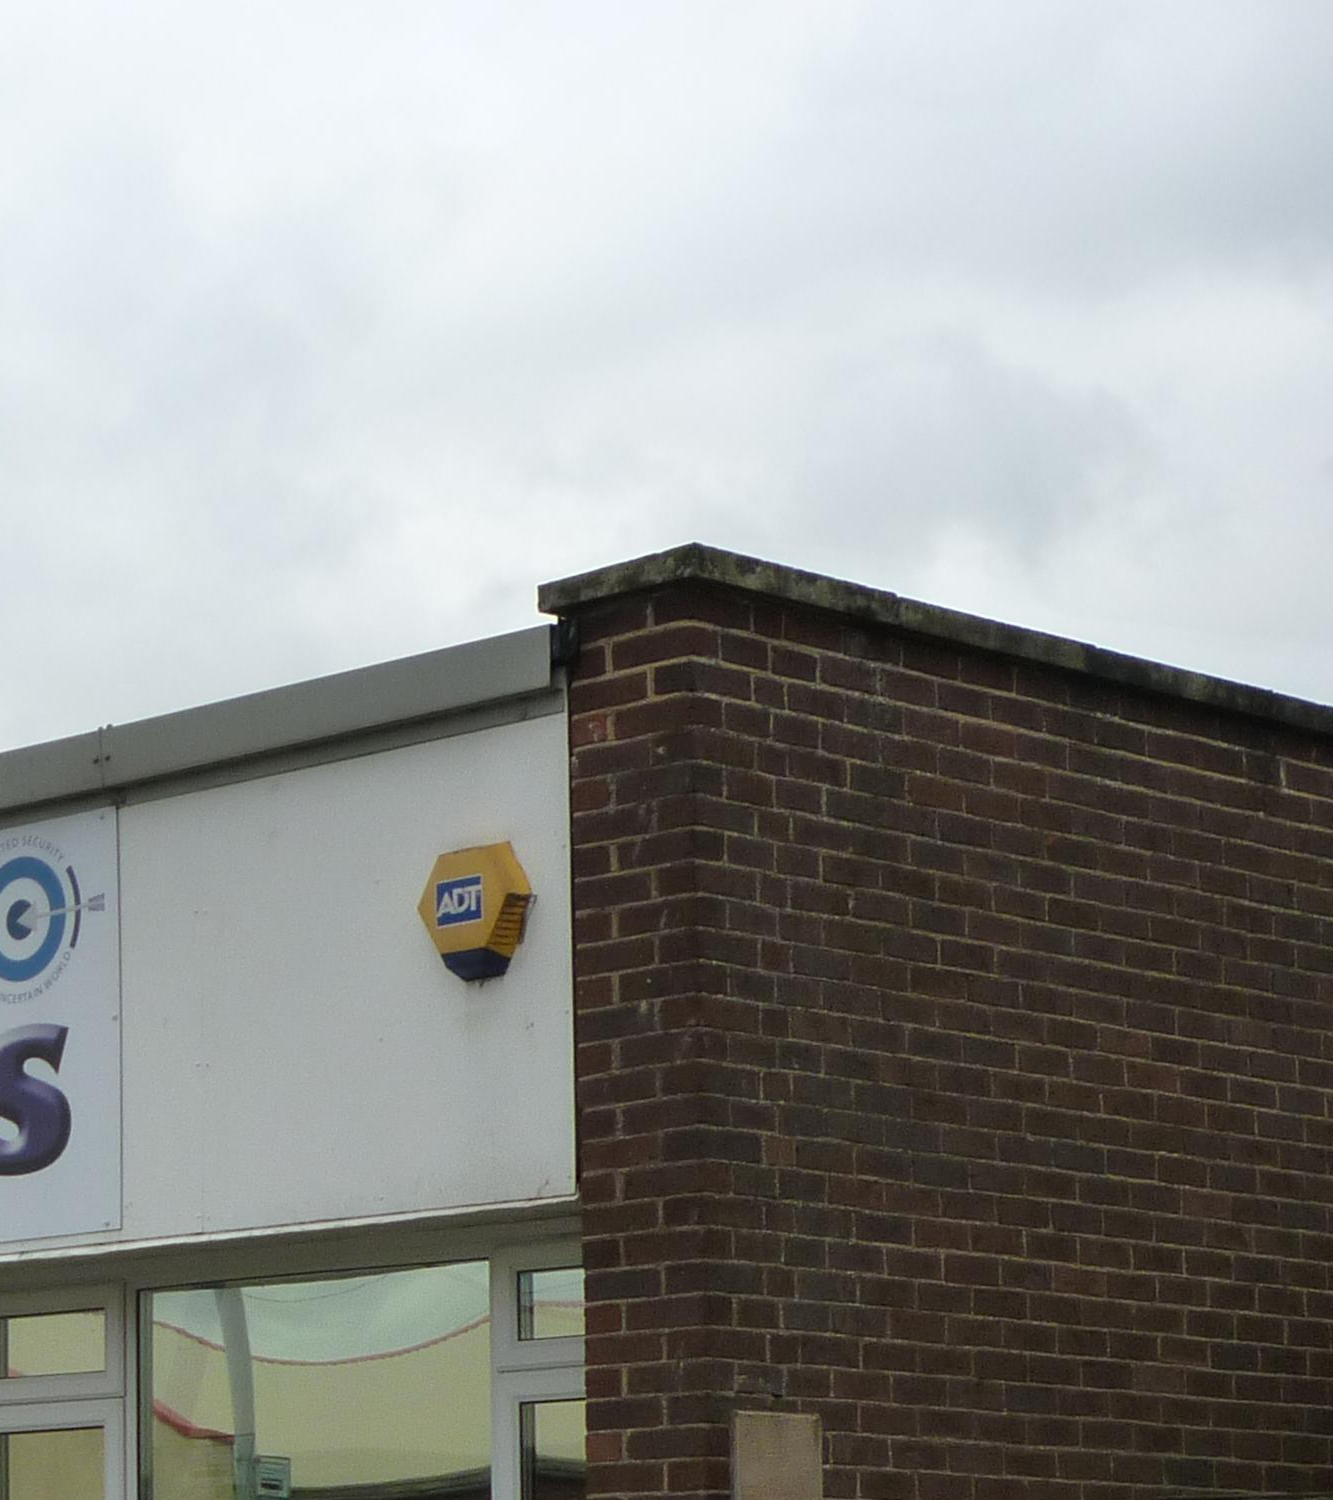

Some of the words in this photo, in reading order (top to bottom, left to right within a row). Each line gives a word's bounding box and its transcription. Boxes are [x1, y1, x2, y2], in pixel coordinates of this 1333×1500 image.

[22, 835, 65, 862] SECURITY
[437, 885, 482, 917] ADT
[44, 952, 72, 990] WORLD
